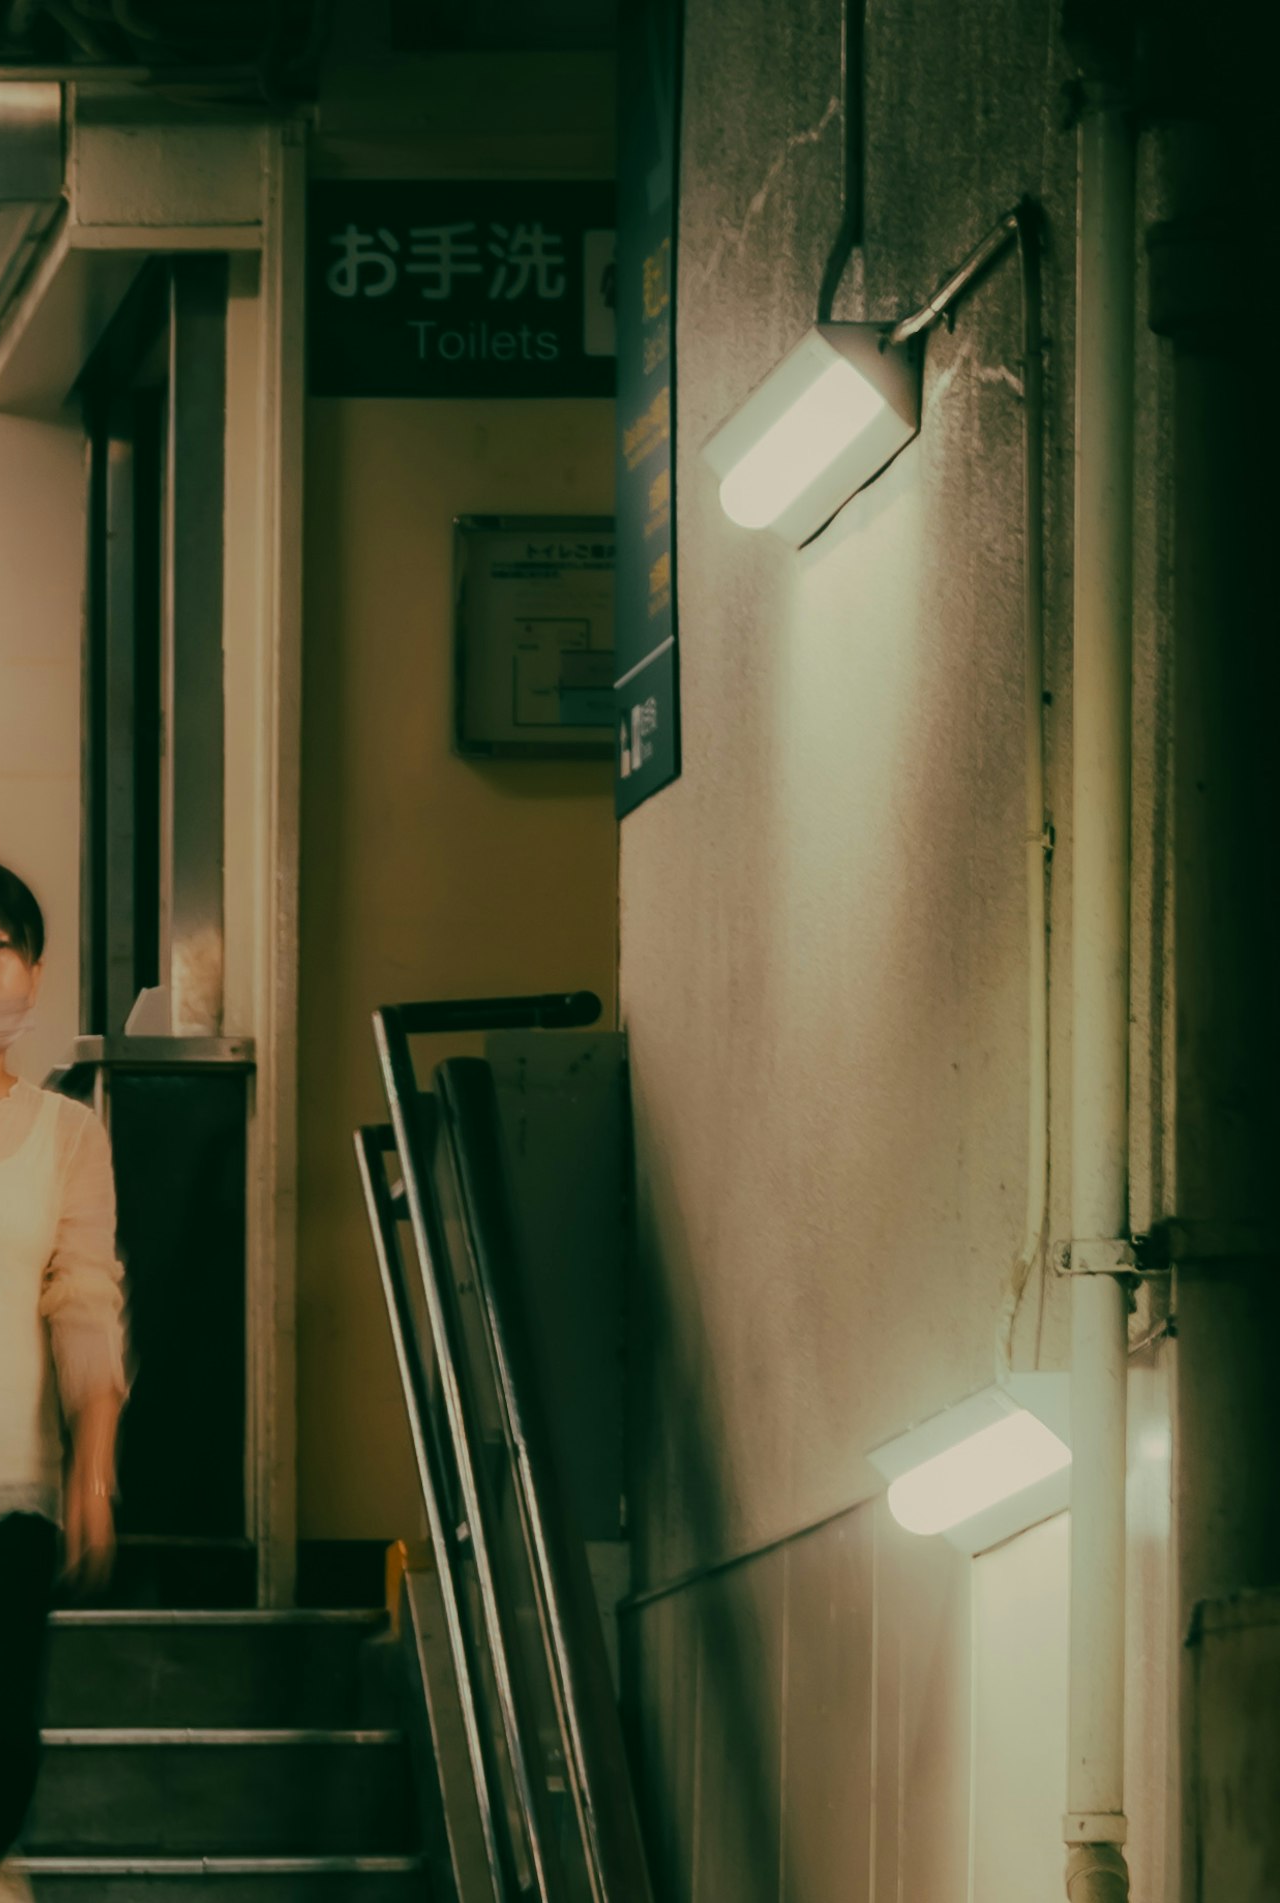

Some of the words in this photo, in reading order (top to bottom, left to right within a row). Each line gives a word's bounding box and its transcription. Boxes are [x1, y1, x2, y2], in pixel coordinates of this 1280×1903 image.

[326, 221, 567, 300] お手洗
[406, 320, 559, 361] Toilets
